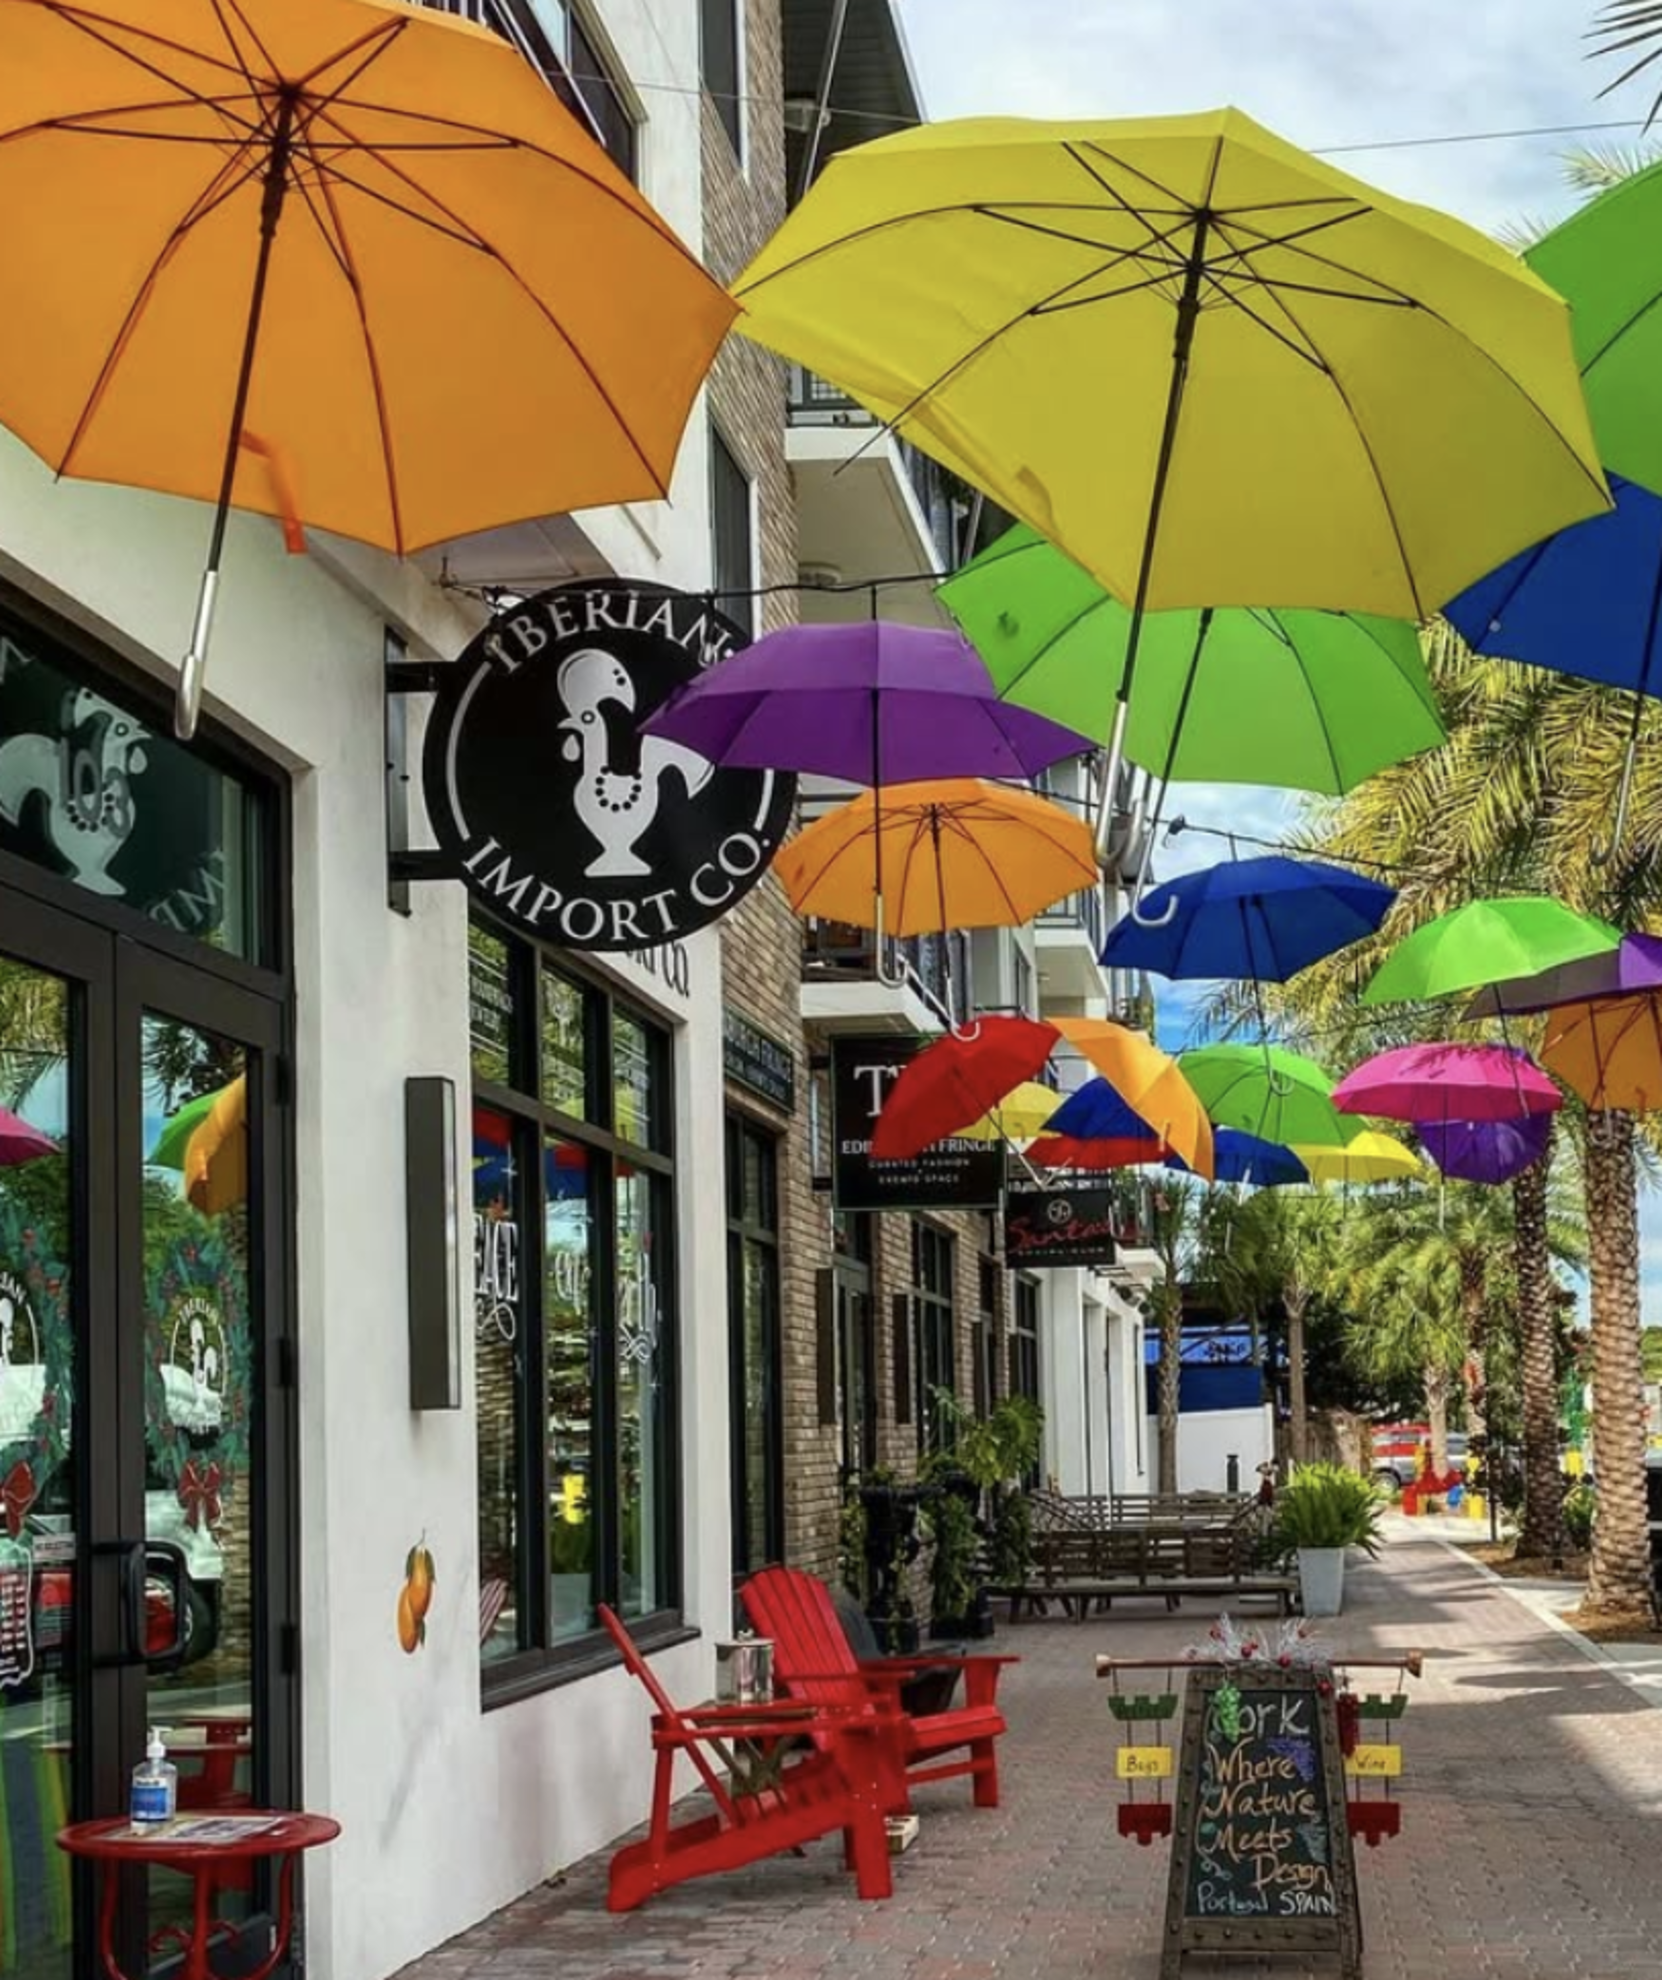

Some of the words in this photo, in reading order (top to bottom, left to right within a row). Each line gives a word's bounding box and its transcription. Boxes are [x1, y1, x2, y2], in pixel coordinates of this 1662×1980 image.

[485, 589, 732, 672] IBERIAN
[463, 837, 681, 942] IMPORT
[690, 832, 771, 907] CO.
[1208, 1737, 1296, 1783] Where
[1203, 1779, 1316, 1818] Nature
[1206, 1817, 1293, 1862] Meets
[1250, 1851, 1332, 1890] Design
[1279, 1889, 1337, 1916] SPAIN
